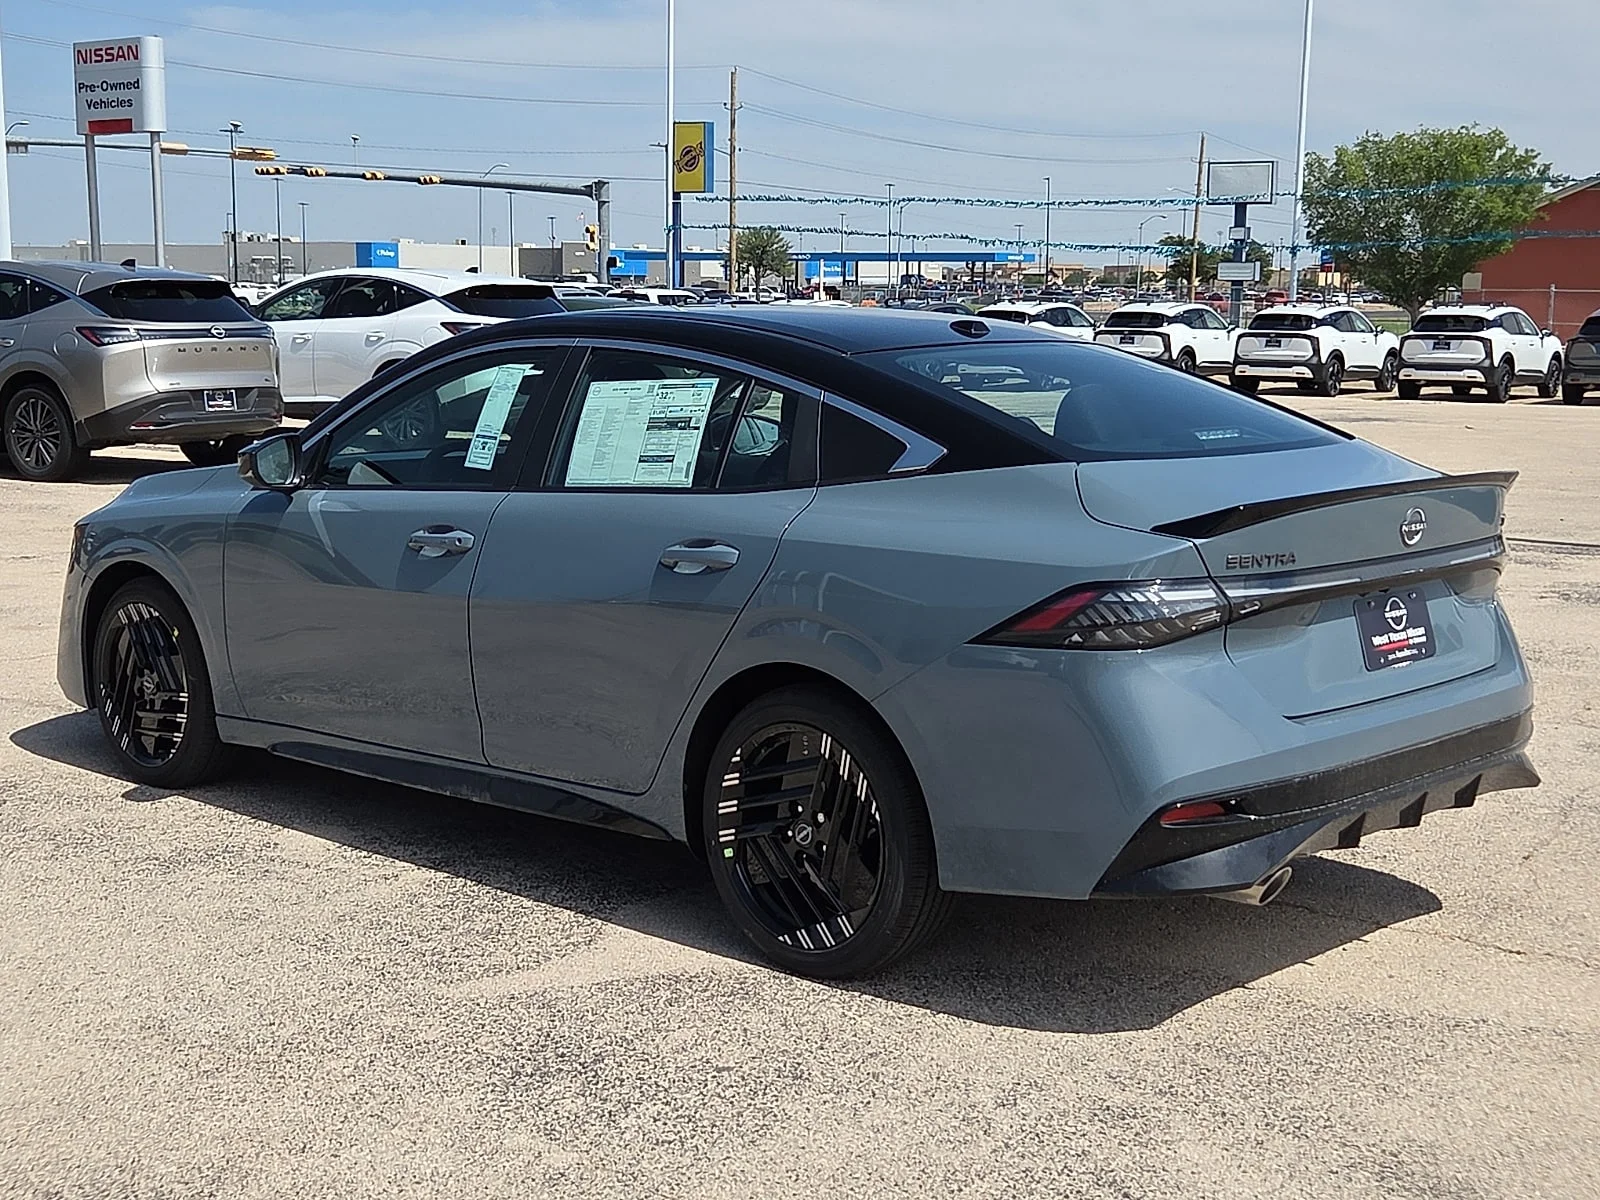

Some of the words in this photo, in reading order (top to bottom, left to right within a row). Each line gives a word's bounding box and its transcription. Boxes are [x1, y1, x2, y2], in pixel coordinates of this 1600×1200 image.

[76, 44, 139, 65] NISSAN
[78, 78, 140, 93] Pre-Owned
[85, 97, 133, 110] Vehicles
[177, 345, 260, 353] MURANO
[1226, 552, 1297, 570] SENTRA
